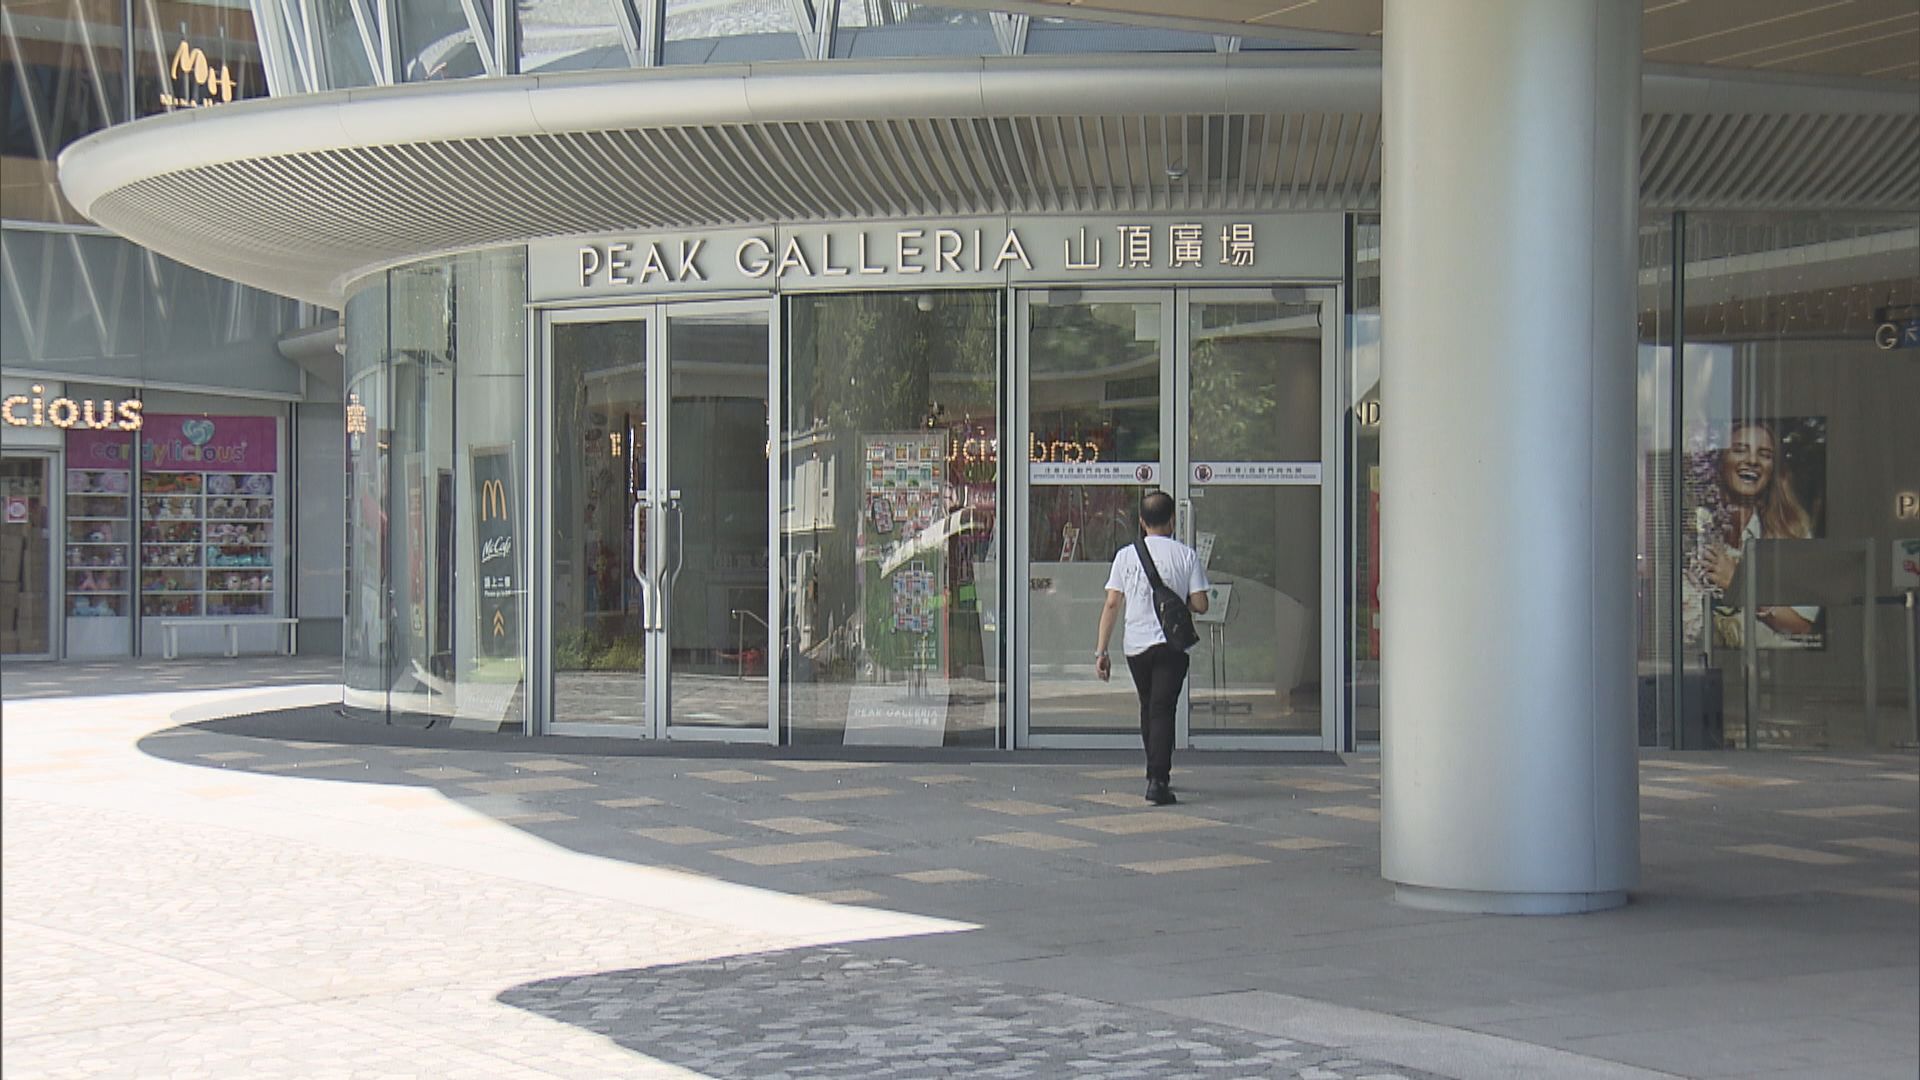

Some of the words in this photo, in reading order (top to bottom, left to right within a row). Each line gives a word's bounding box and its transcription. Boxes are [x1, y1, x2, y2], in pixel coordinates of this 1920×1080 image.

[579, 239, 707, 287] PEAK
[736, 229, 1034, 278] GALLERIA
[1064, 223, 1255, 270] 山頂廣場
[2, 384, 143, 431] cious
